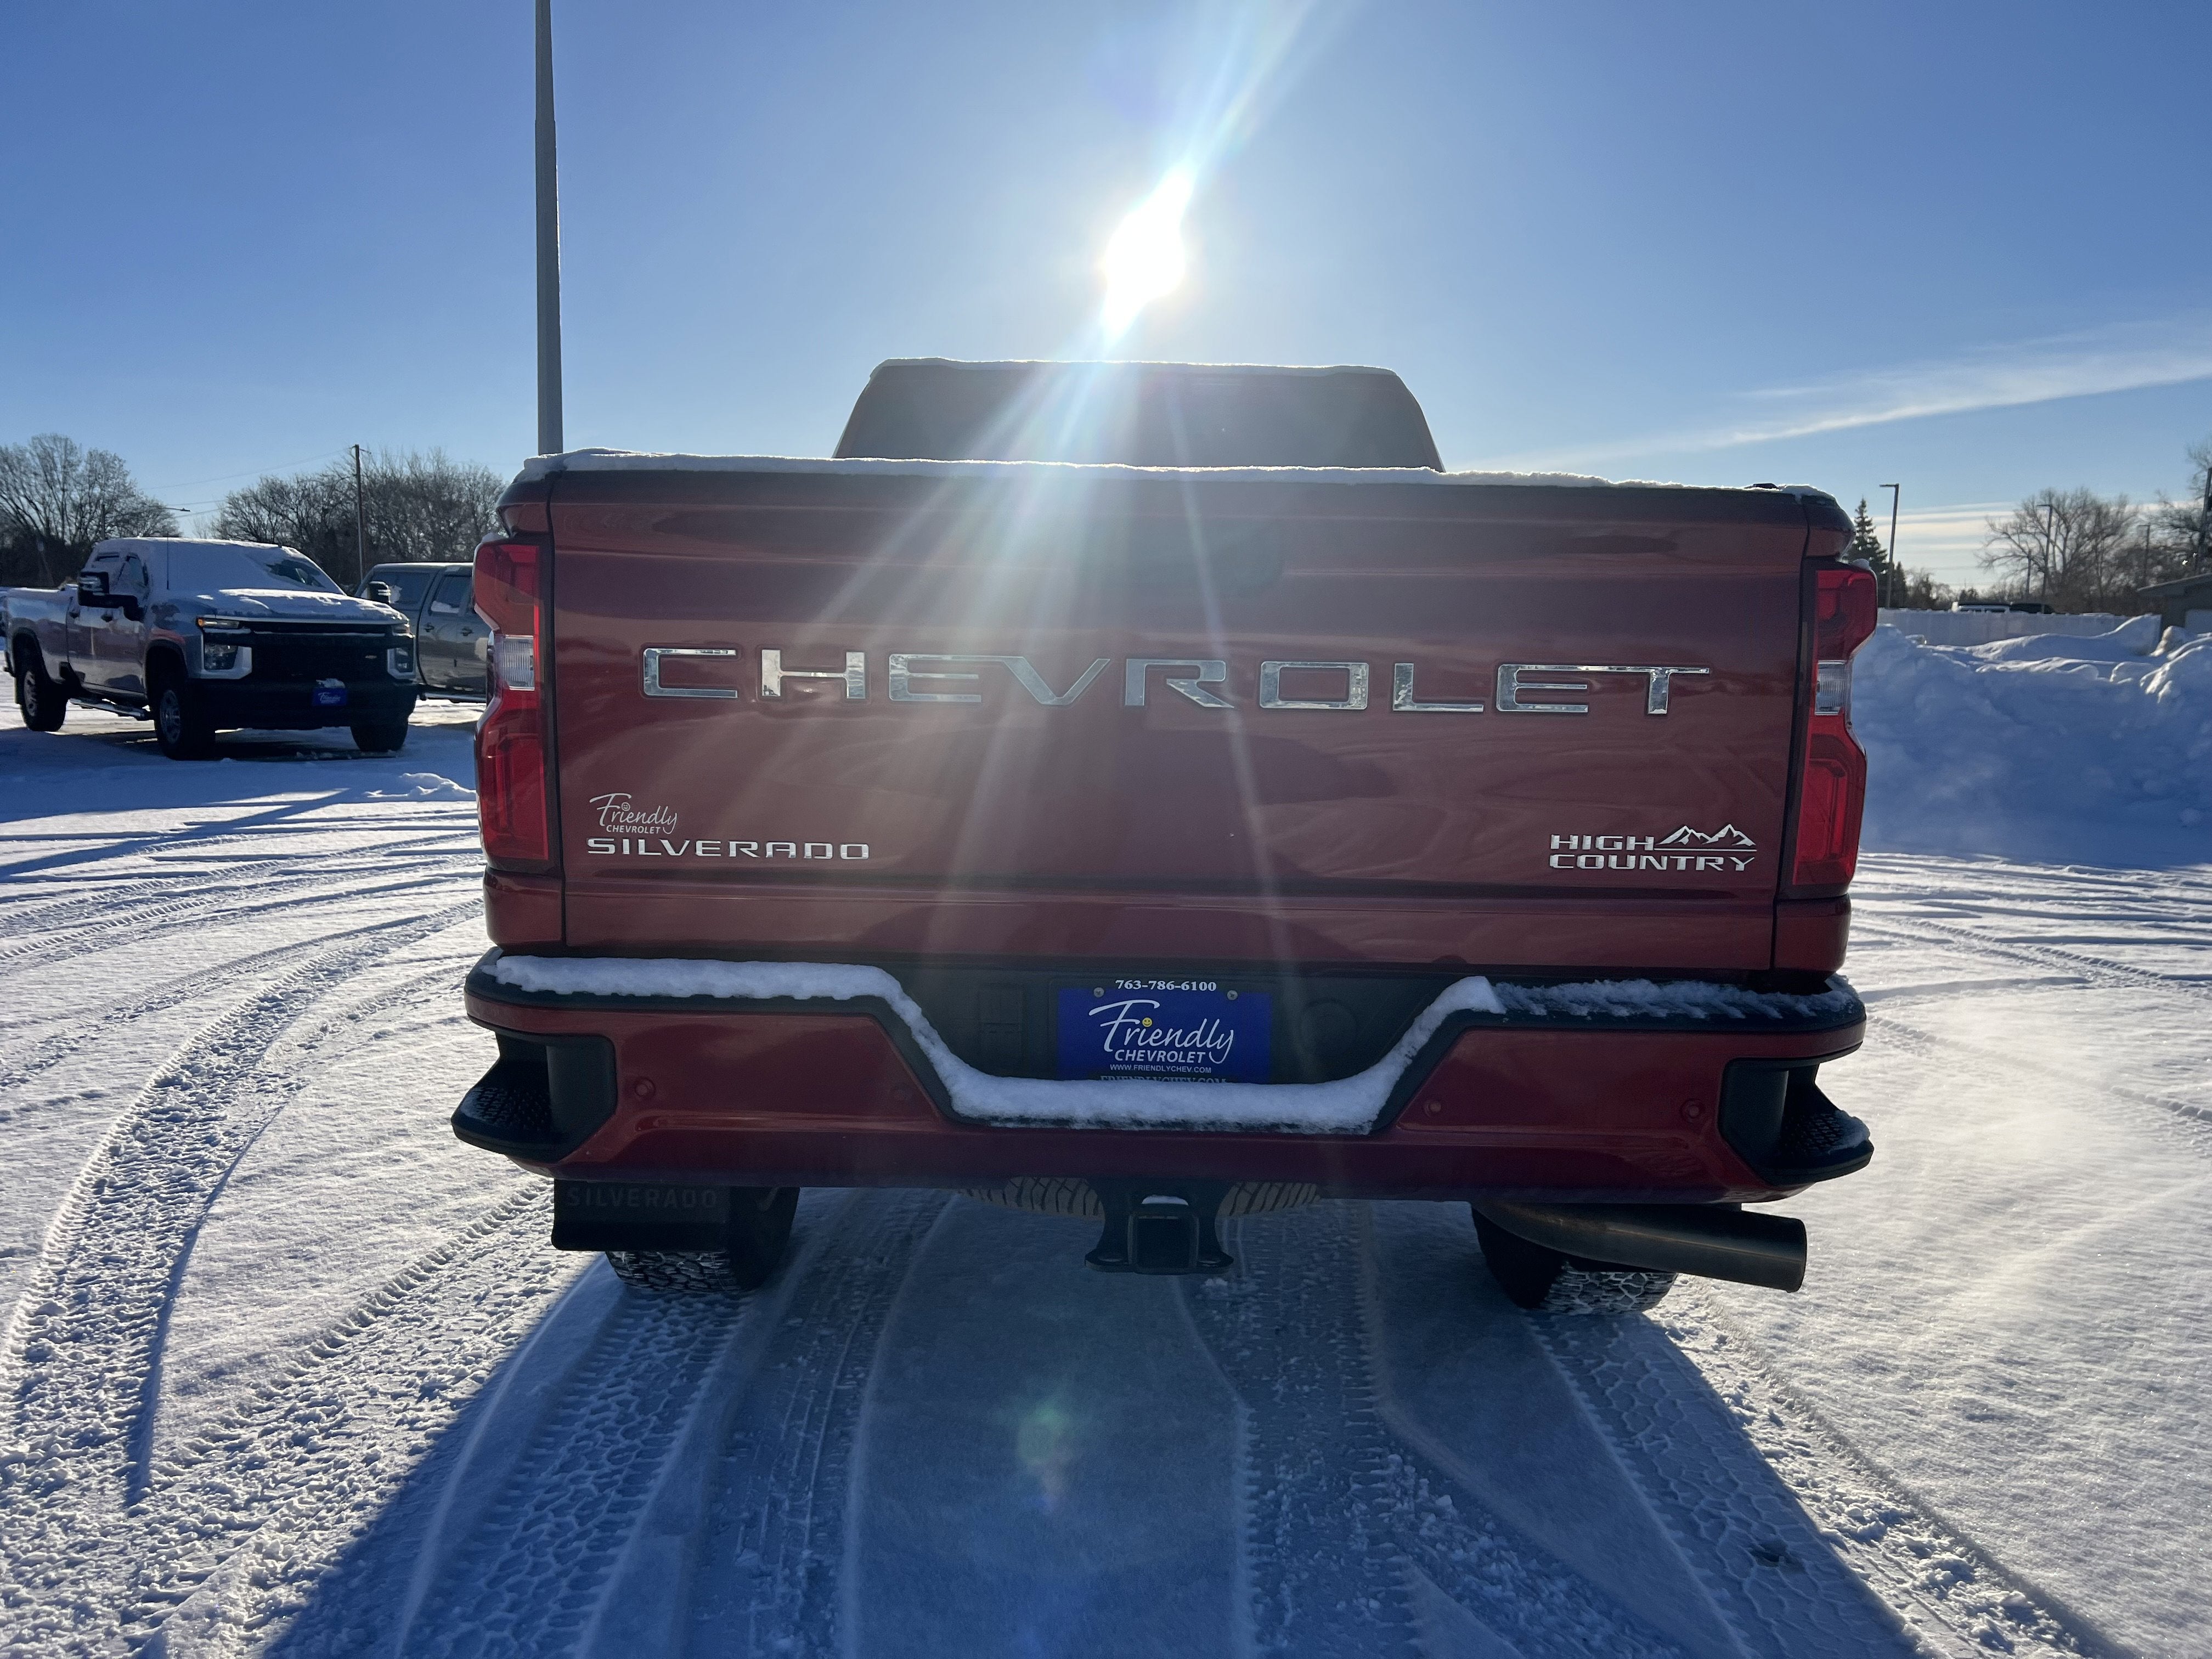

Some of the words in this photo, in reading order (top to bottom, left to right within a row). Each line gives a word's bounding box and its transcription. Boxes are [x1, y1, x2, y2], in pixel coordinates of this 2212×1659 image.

[642, 645, 1708, 715] CHEVROLET
[589, 793, 678, 834] Friendly
[606, 824, 661, 834] CHEVROLET
[587, 838, 870, 859] SILVERADO
[1550, 834, 1654, 850] HIGH
[1549, 854, 1756, 871] COUNTRY
[1115, 980, 1217, 991] 763-786-6100
[1088, 999, 1234, 1064] Friendly
[1114, 1049, 1206, 1064] CHEVROLET
[1110, 1064, 1211, 1073] WWW.FRIENDLYCHEV.COM
[567, 1187, 716, 1207] SILVERADO
